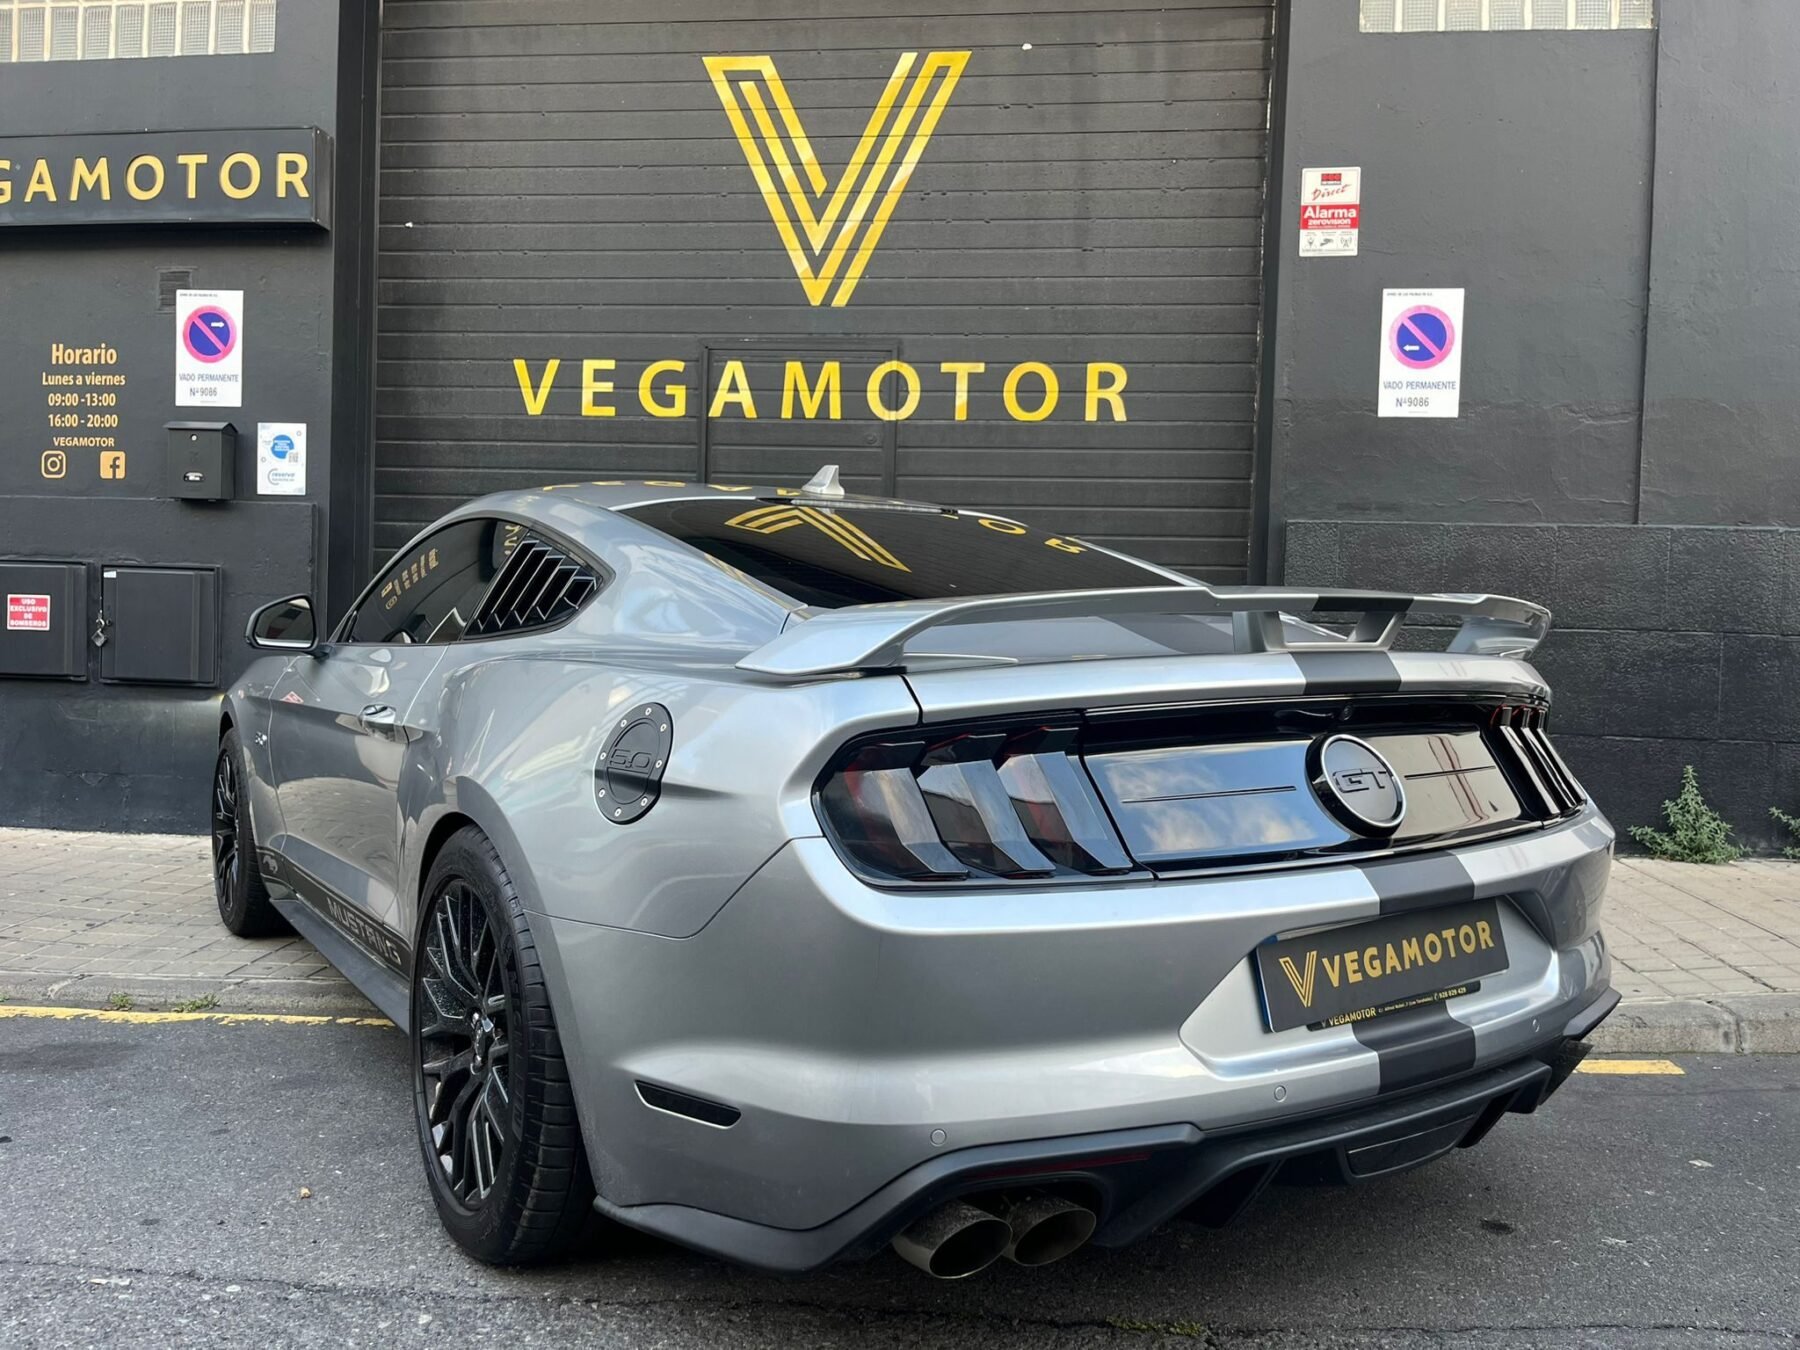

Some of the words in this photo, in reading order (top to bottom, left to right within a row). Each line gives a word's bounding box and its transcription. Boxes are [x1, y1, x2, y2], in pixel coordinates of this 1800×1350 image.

[1303, 205, 1357, 219] Alarma
[1307, 218, 1351, 226] zerovision
[51, 343, 117, 365] Horario
[42, 371, 74, 386] Lunes
[76, 375, 83, 386] a
[85, 371, 126, 386] viernes
[179, 373, 196, 382] VADO
[197, 373, 239, 383] PERMANENTE
[513, 358, 1129, 422] VEGAMOTOR
[1383, 381, 1403, 390] VADO
[1405, 381, 1456, 391] PERMANENTE
[48, 393, 79, 407] 09:00
[48, 414, 79, 427] 16:00
[86, 414, 118, 427] 20:00
[53, 437, 115, 447] VEGAMOTOR
[1332, 767, 1387, 793] GT
[326, 896, 402, 966] MUSTANG
[1321, 920, 1495, 989] VEGAMOTOR
[1328, 1006, 1377, 1026] VEGAMOTOR
